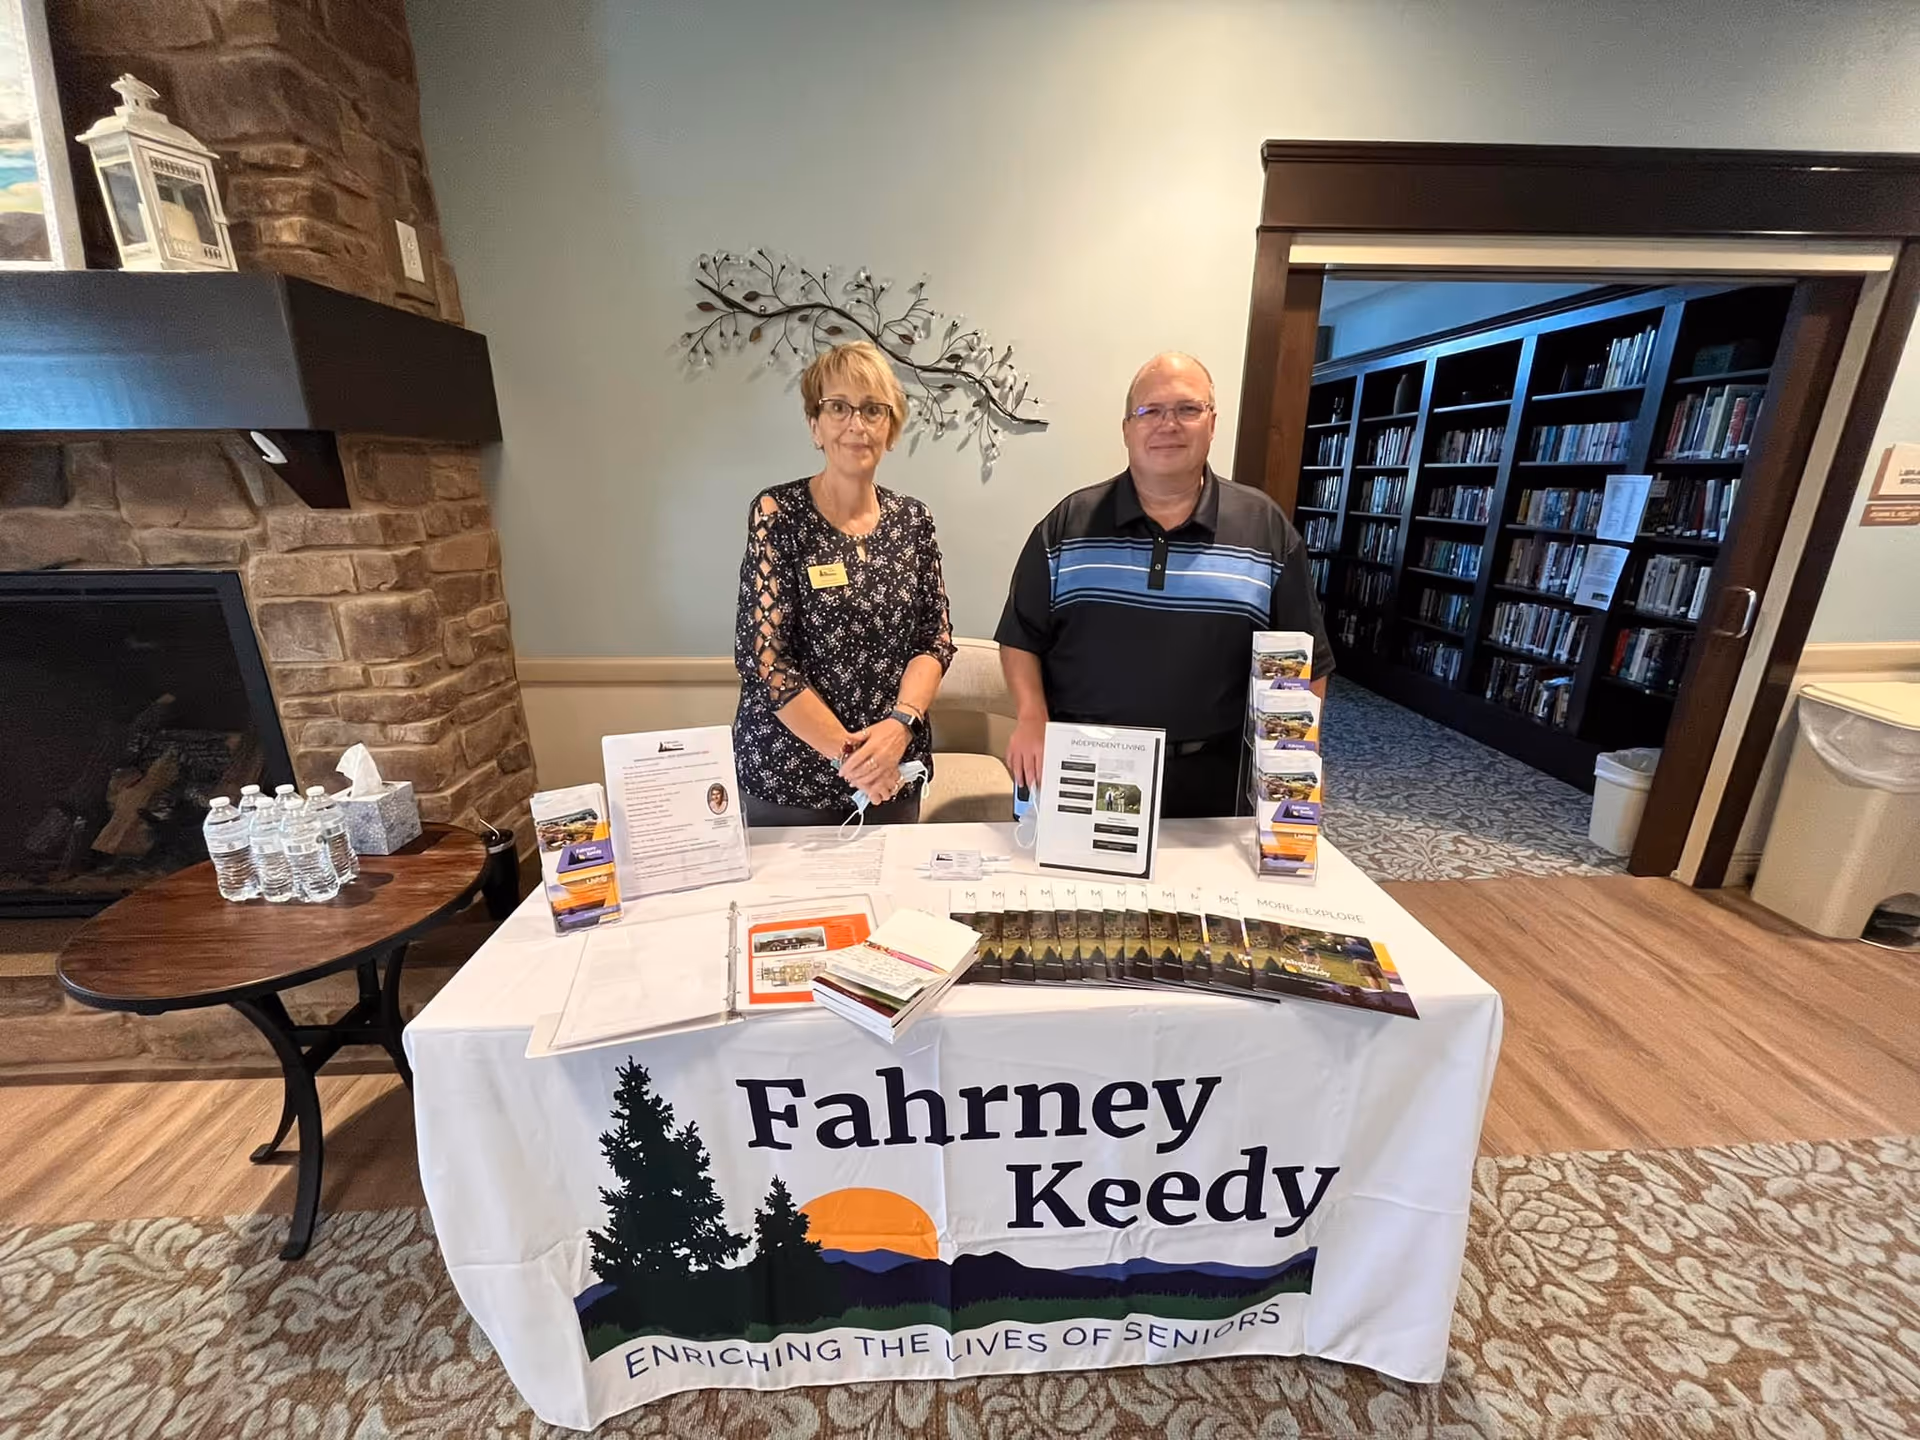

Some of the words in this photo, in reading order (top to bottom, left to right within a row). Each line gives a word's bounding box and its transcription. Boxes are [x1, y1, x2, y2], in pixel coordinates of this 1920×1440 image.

[1070, 738, 1121, 750] INDEPENDENT
[1121, 743, 1146, 752] LIVING
[1256, 898, 1294, 914] MORE
[1305, 906, 1365, 925] EXPLORE
[736, 1067, 1221, 1154] Fahrney
[1006, 1146, 1340, 1238] Keedy
[625, 1338, 842, 1379] ENRICHING
[854, 1332, 930, 1359] THE
[945, 1329, 1048, 1362] LIVES
[1062, 1326, 1112, 1347] OF
[1123, 1303, 1280, 1349] SENIORS
